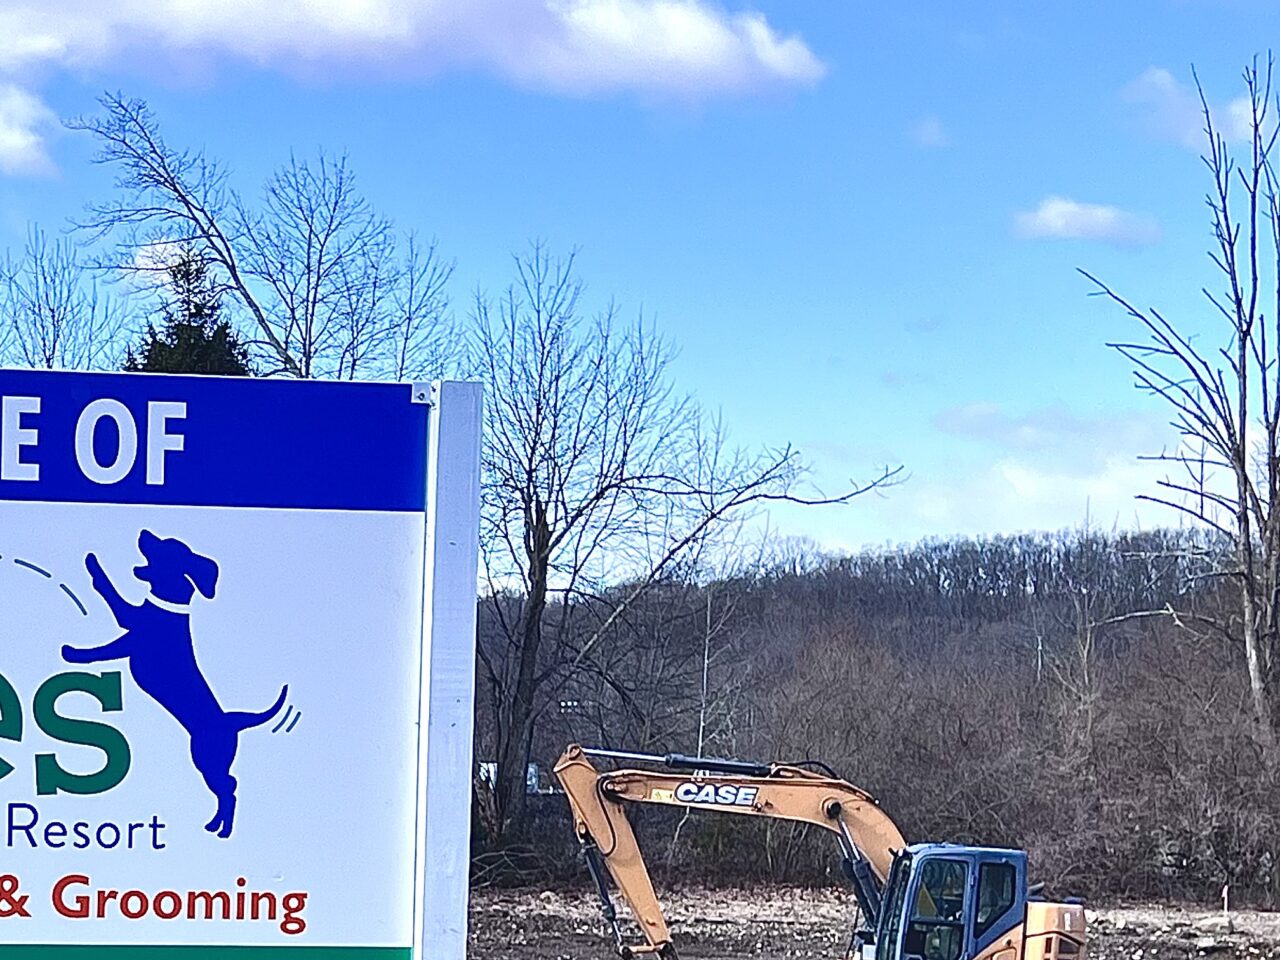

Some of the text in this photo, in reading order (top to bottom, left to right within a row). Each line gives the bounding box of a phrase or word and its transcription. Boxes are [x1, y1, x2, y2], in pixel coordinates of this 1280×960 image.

[74, 396, 187, 486] OF
[675, 781, 759, 806] CASE
[7, 802, 166, 850] Resort
[53, 876, 306, 933] Grooming
